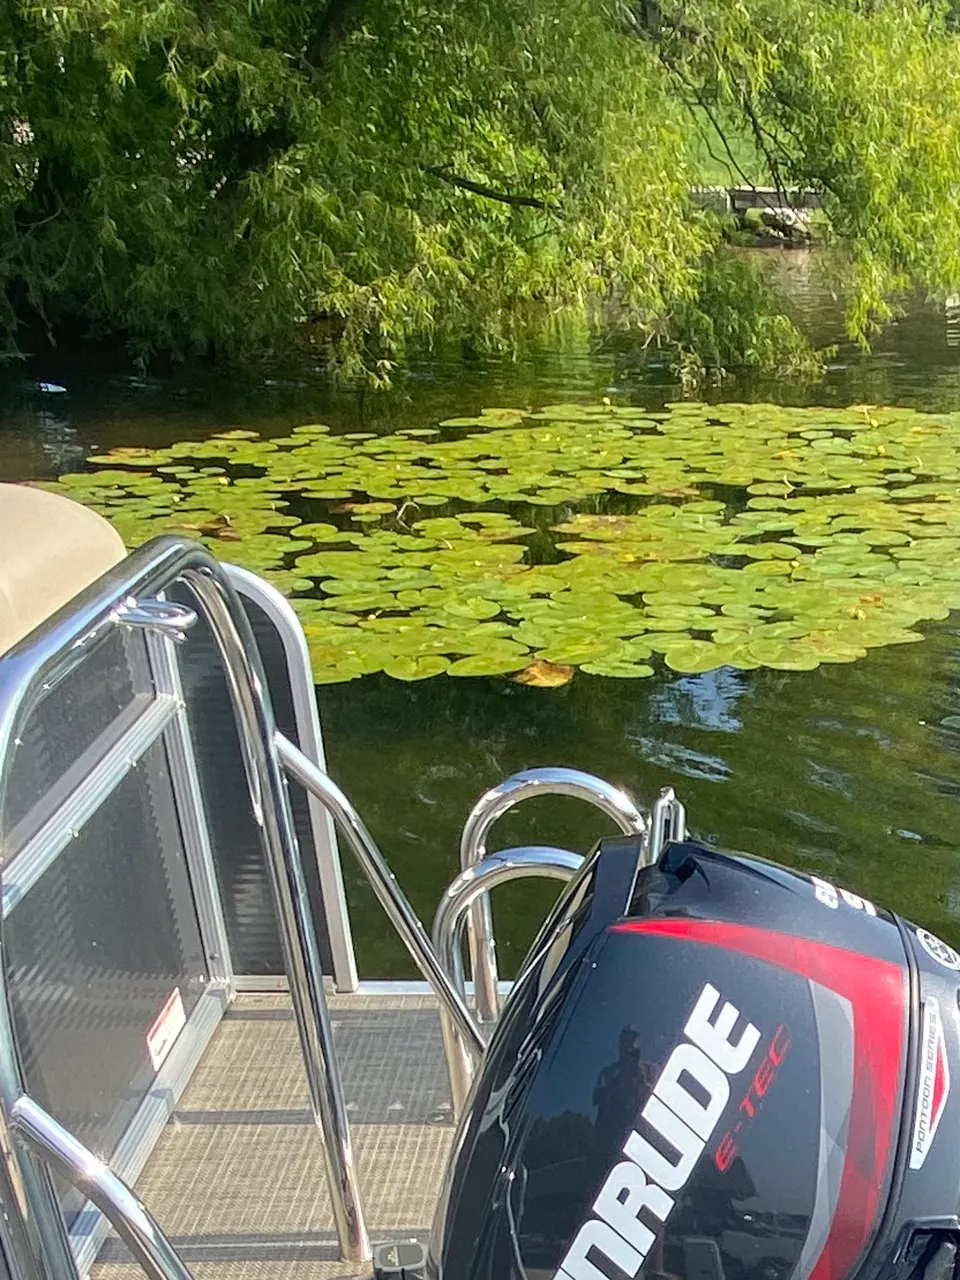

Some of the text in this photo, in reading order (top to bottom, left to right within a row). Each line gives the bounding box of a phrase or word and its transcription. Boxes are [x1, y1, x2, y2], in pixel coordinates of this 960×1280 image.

[715, 1023, 793, 1173] E-TEC
[915, 1012, 938, 1154] PONTOON SERIES
